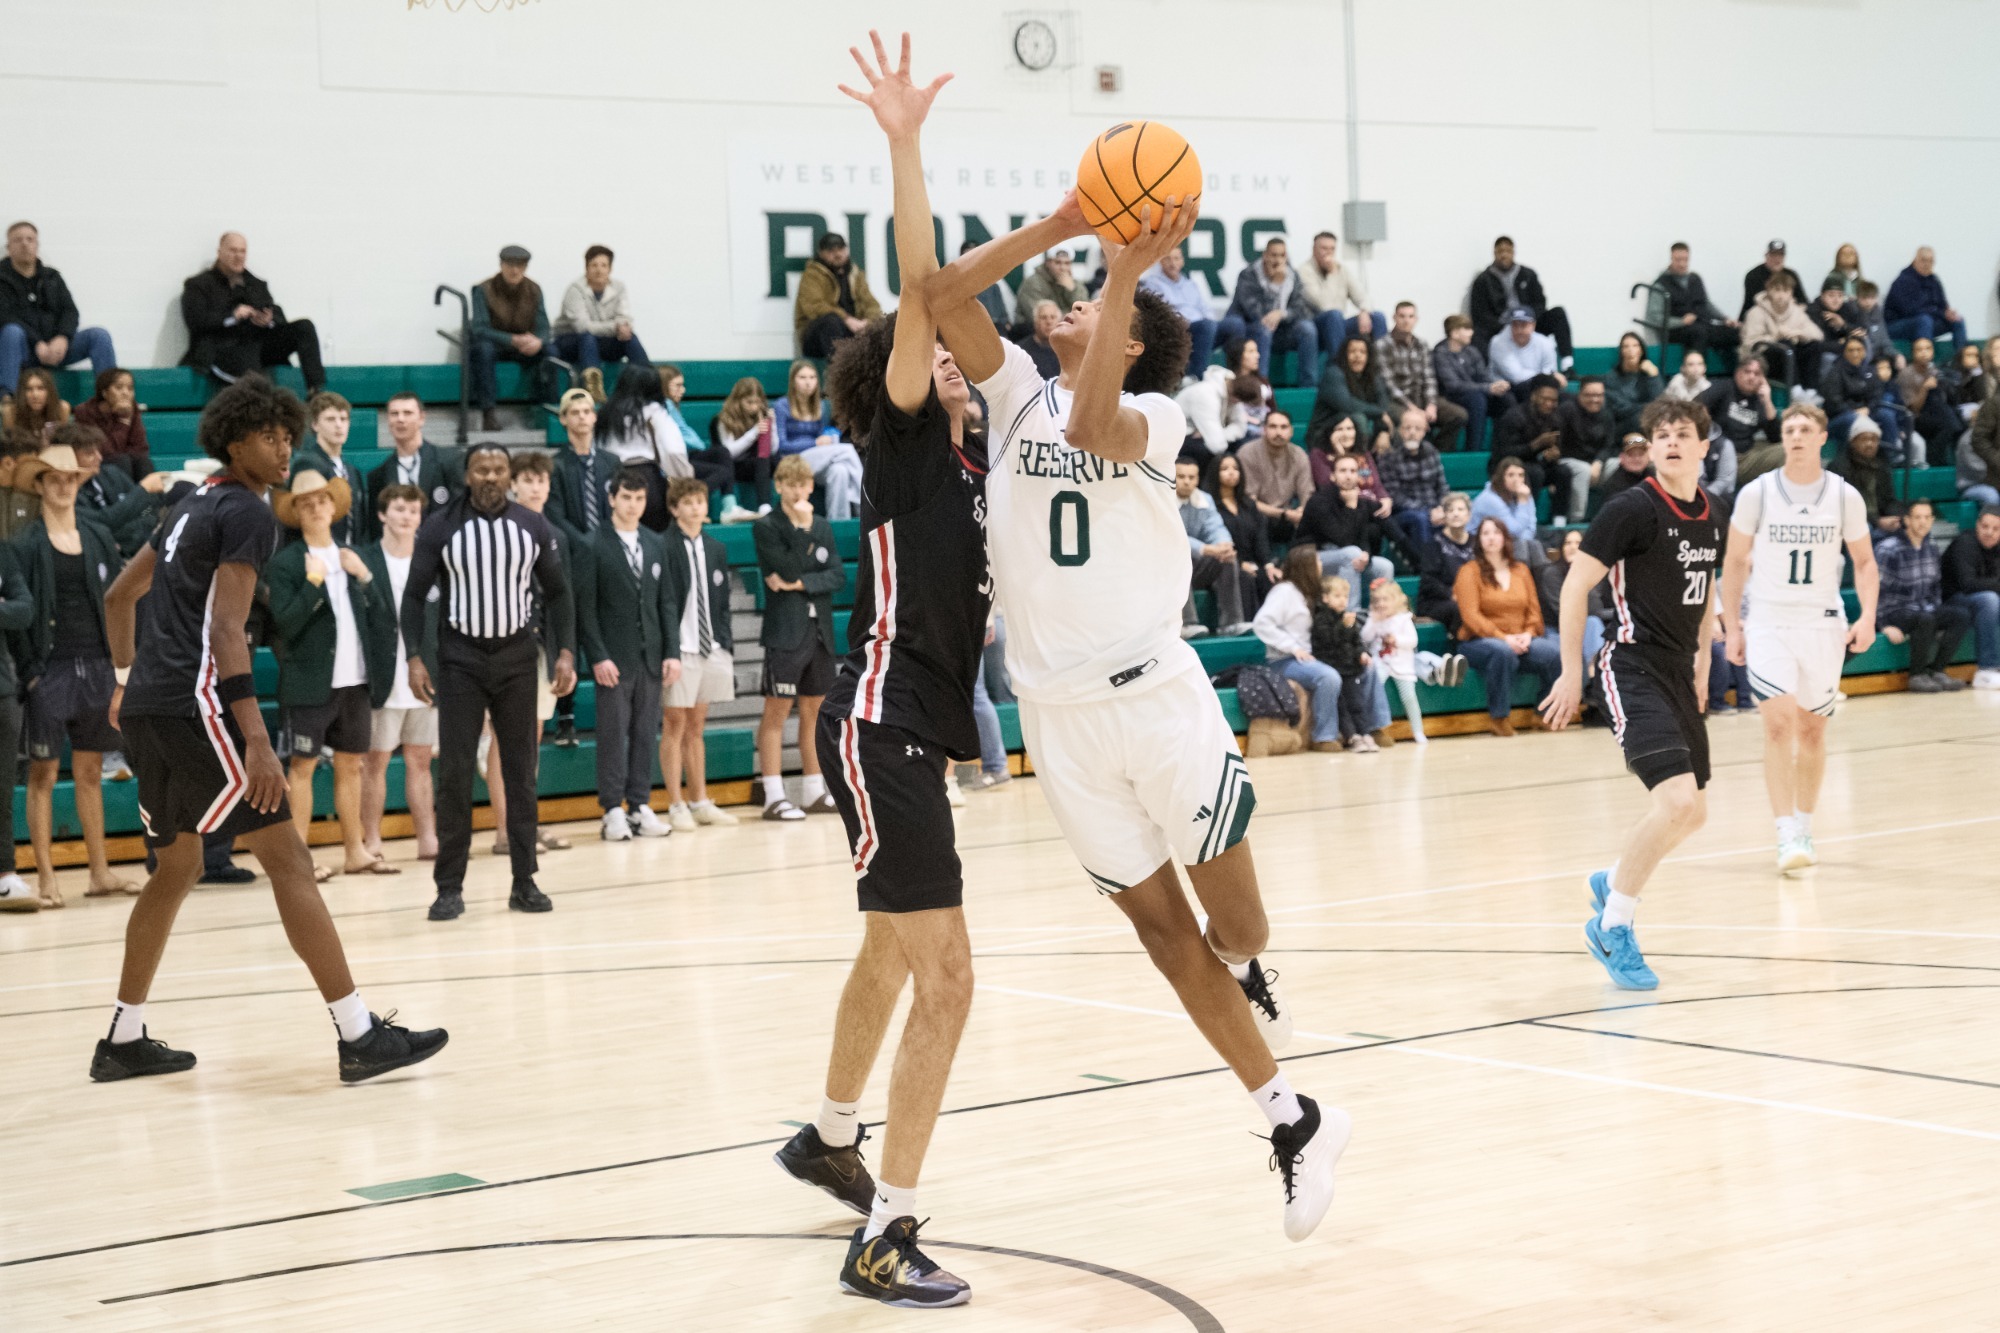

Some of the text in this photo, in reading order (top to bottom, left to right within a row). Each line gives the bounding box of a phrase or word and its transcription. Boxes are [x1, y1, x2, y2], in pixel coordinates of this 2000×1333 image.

[761, 164, 1291, 193] WESTEN RESER DEMY
[763, 210, 1287, 298] PIONRS
[164, 512, 190, 563] 4
[1049, 490, 1091, 567] 0
[1676, 540, 1717, 569] Spire
[1788, 549, 1813, 585] 11
[1682, 570, 1707, 605] 20
